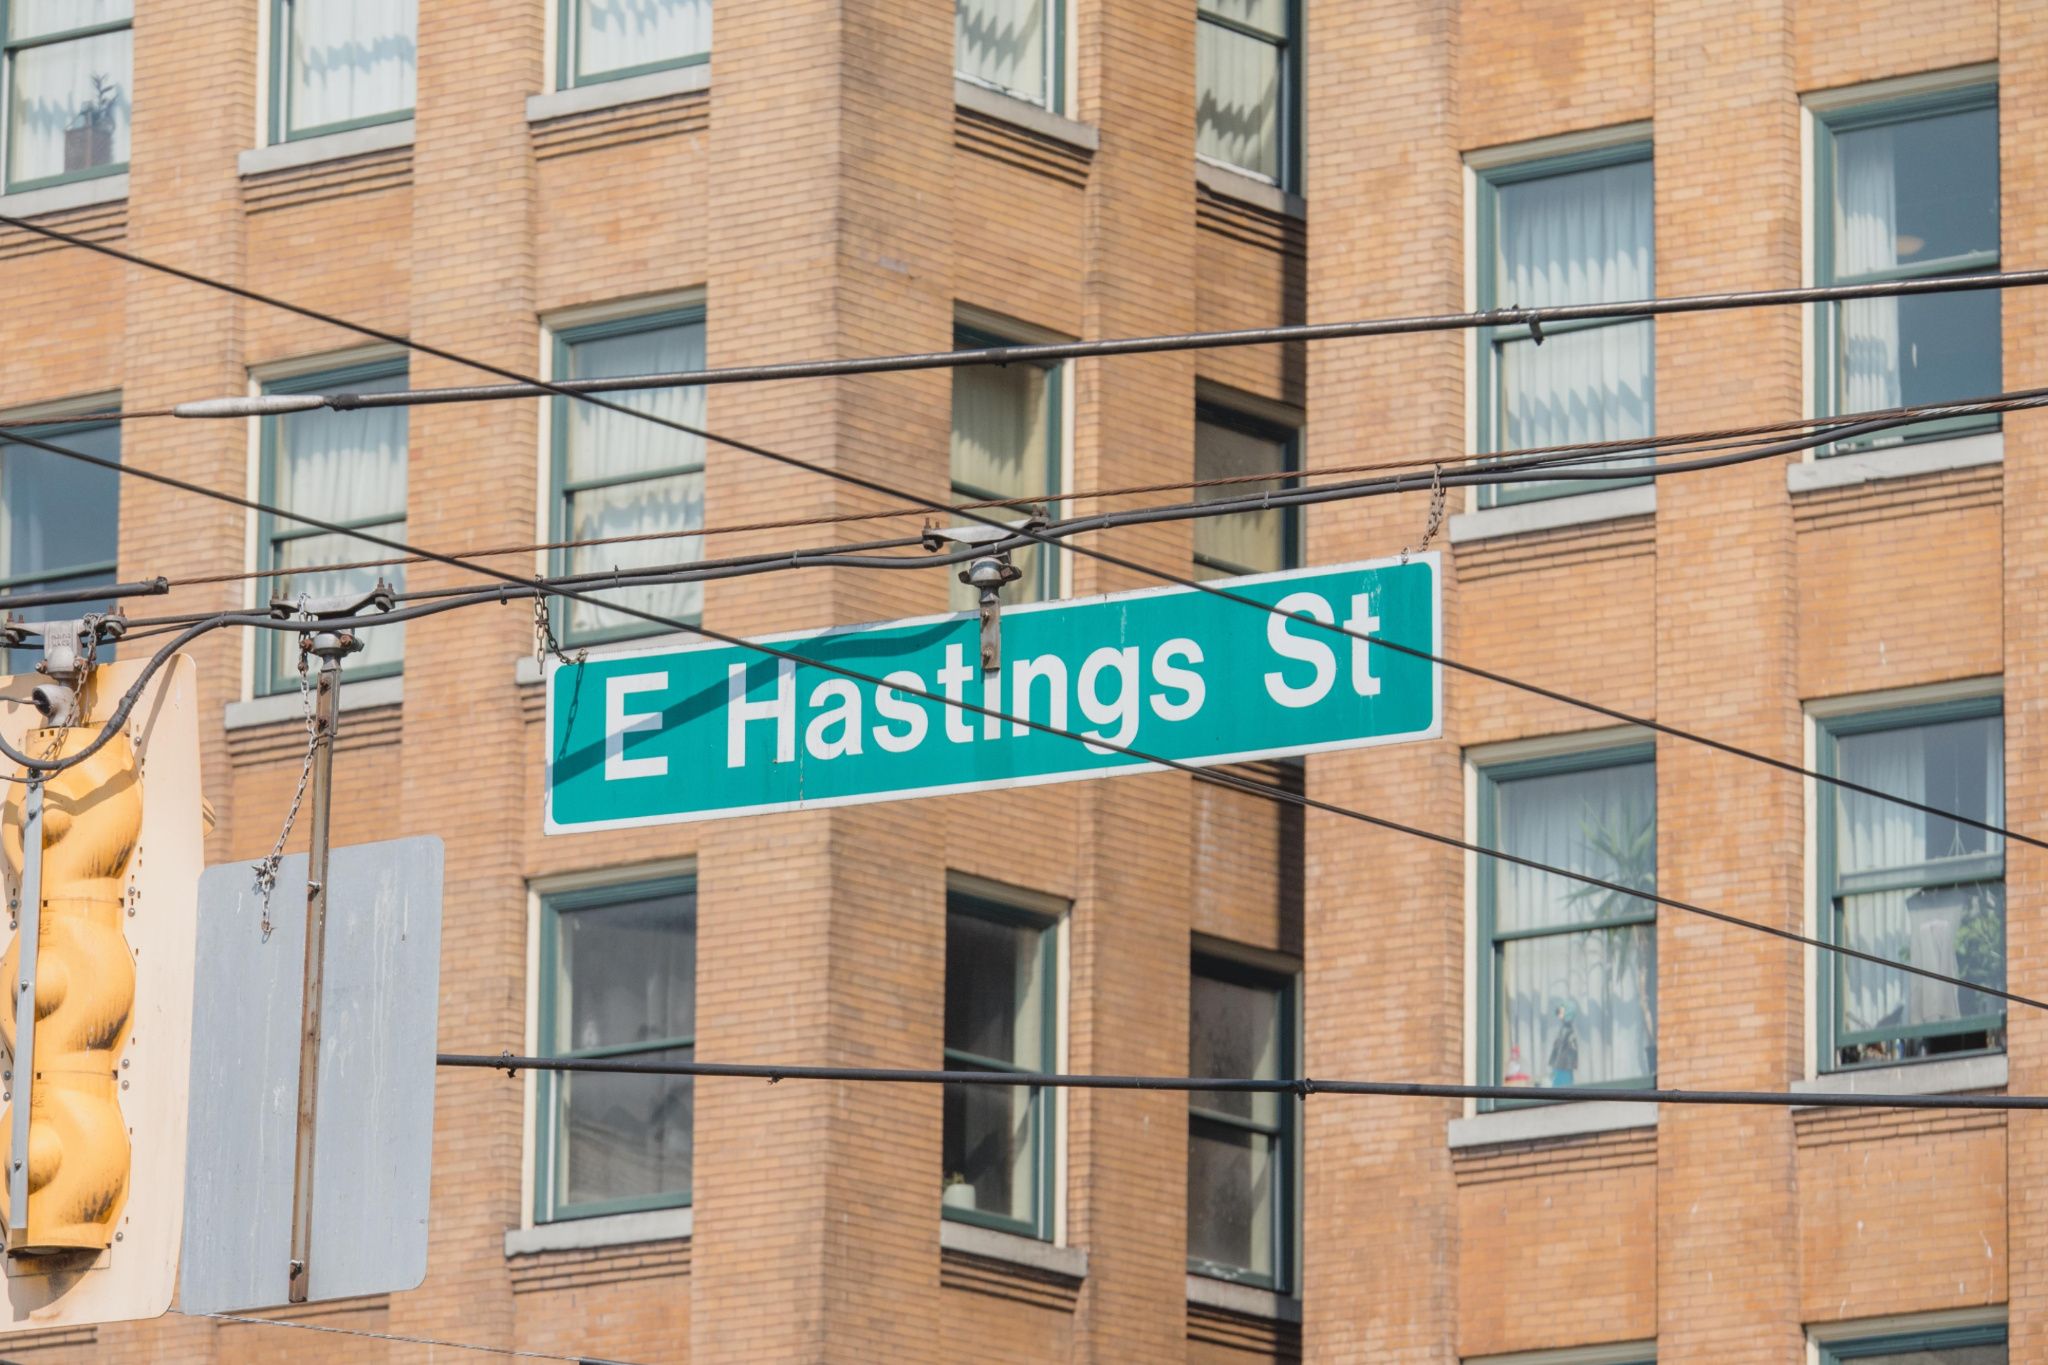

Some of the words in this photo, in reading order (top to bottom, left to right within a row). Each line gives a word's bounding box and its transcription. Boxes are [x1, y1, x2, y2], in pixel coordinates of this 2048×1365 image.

[604, 671, 669, 781] E
[727, 637, 1206, 769] Hastings
[1264, 591, 1381, 708] St
